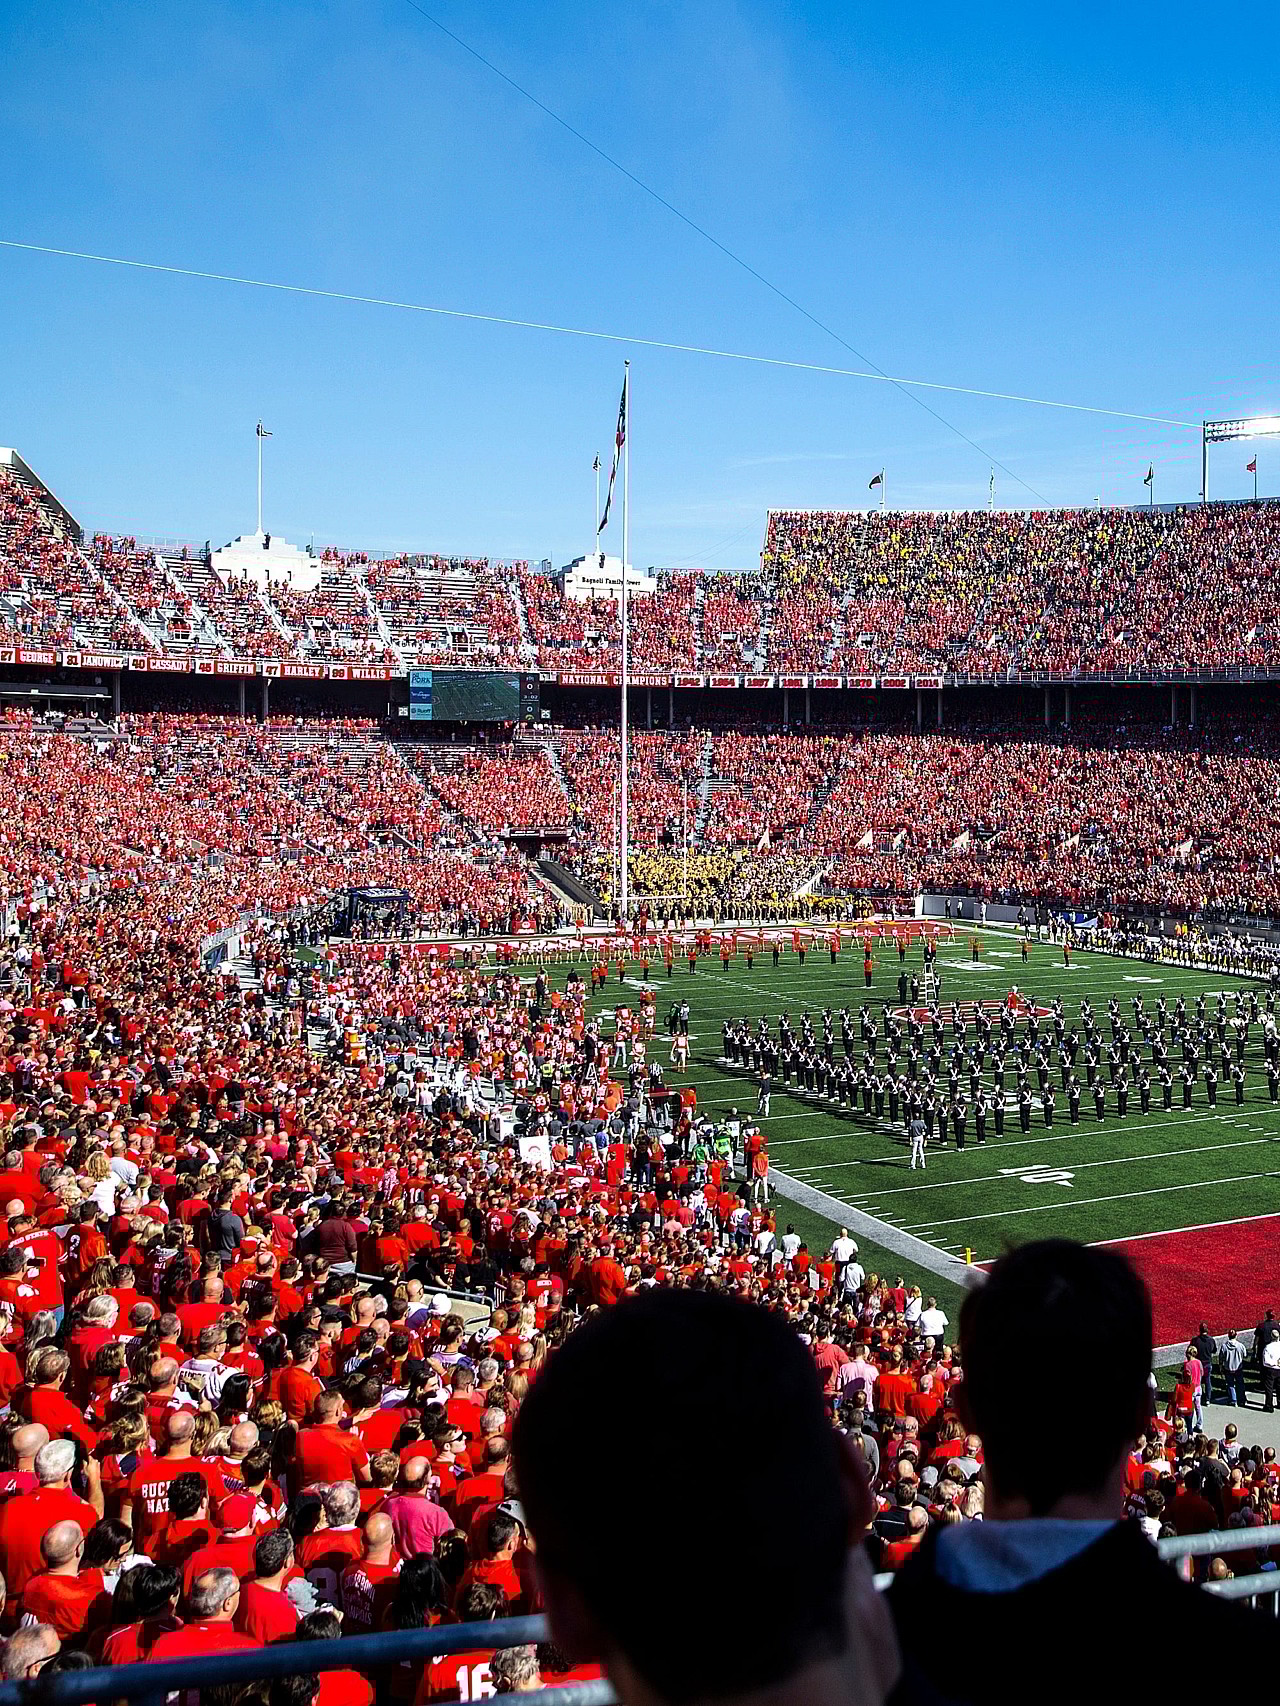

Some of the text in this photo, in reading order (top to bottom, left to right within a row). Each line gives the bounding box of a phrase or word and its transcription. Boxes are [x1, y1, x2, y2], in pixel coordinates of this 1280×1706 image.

[20, 652, 54, 664] GEORGE
[82, 655, 124, 668] JANOWICZ
[132, 658, 188, 671] 40 CASSADY
[199, 662, 254, 674] 45 GRIFFIN
[265, 666, 321, 677] 47 HARLEY
[352, 668, 386, 679] WILLIS
[561, 674, 608, 685] NATIONAL
[883, 678, 906, 687] 2002
[916, 678, 939, 687] 2014
[141, 1481, 170, 1499] BUC
